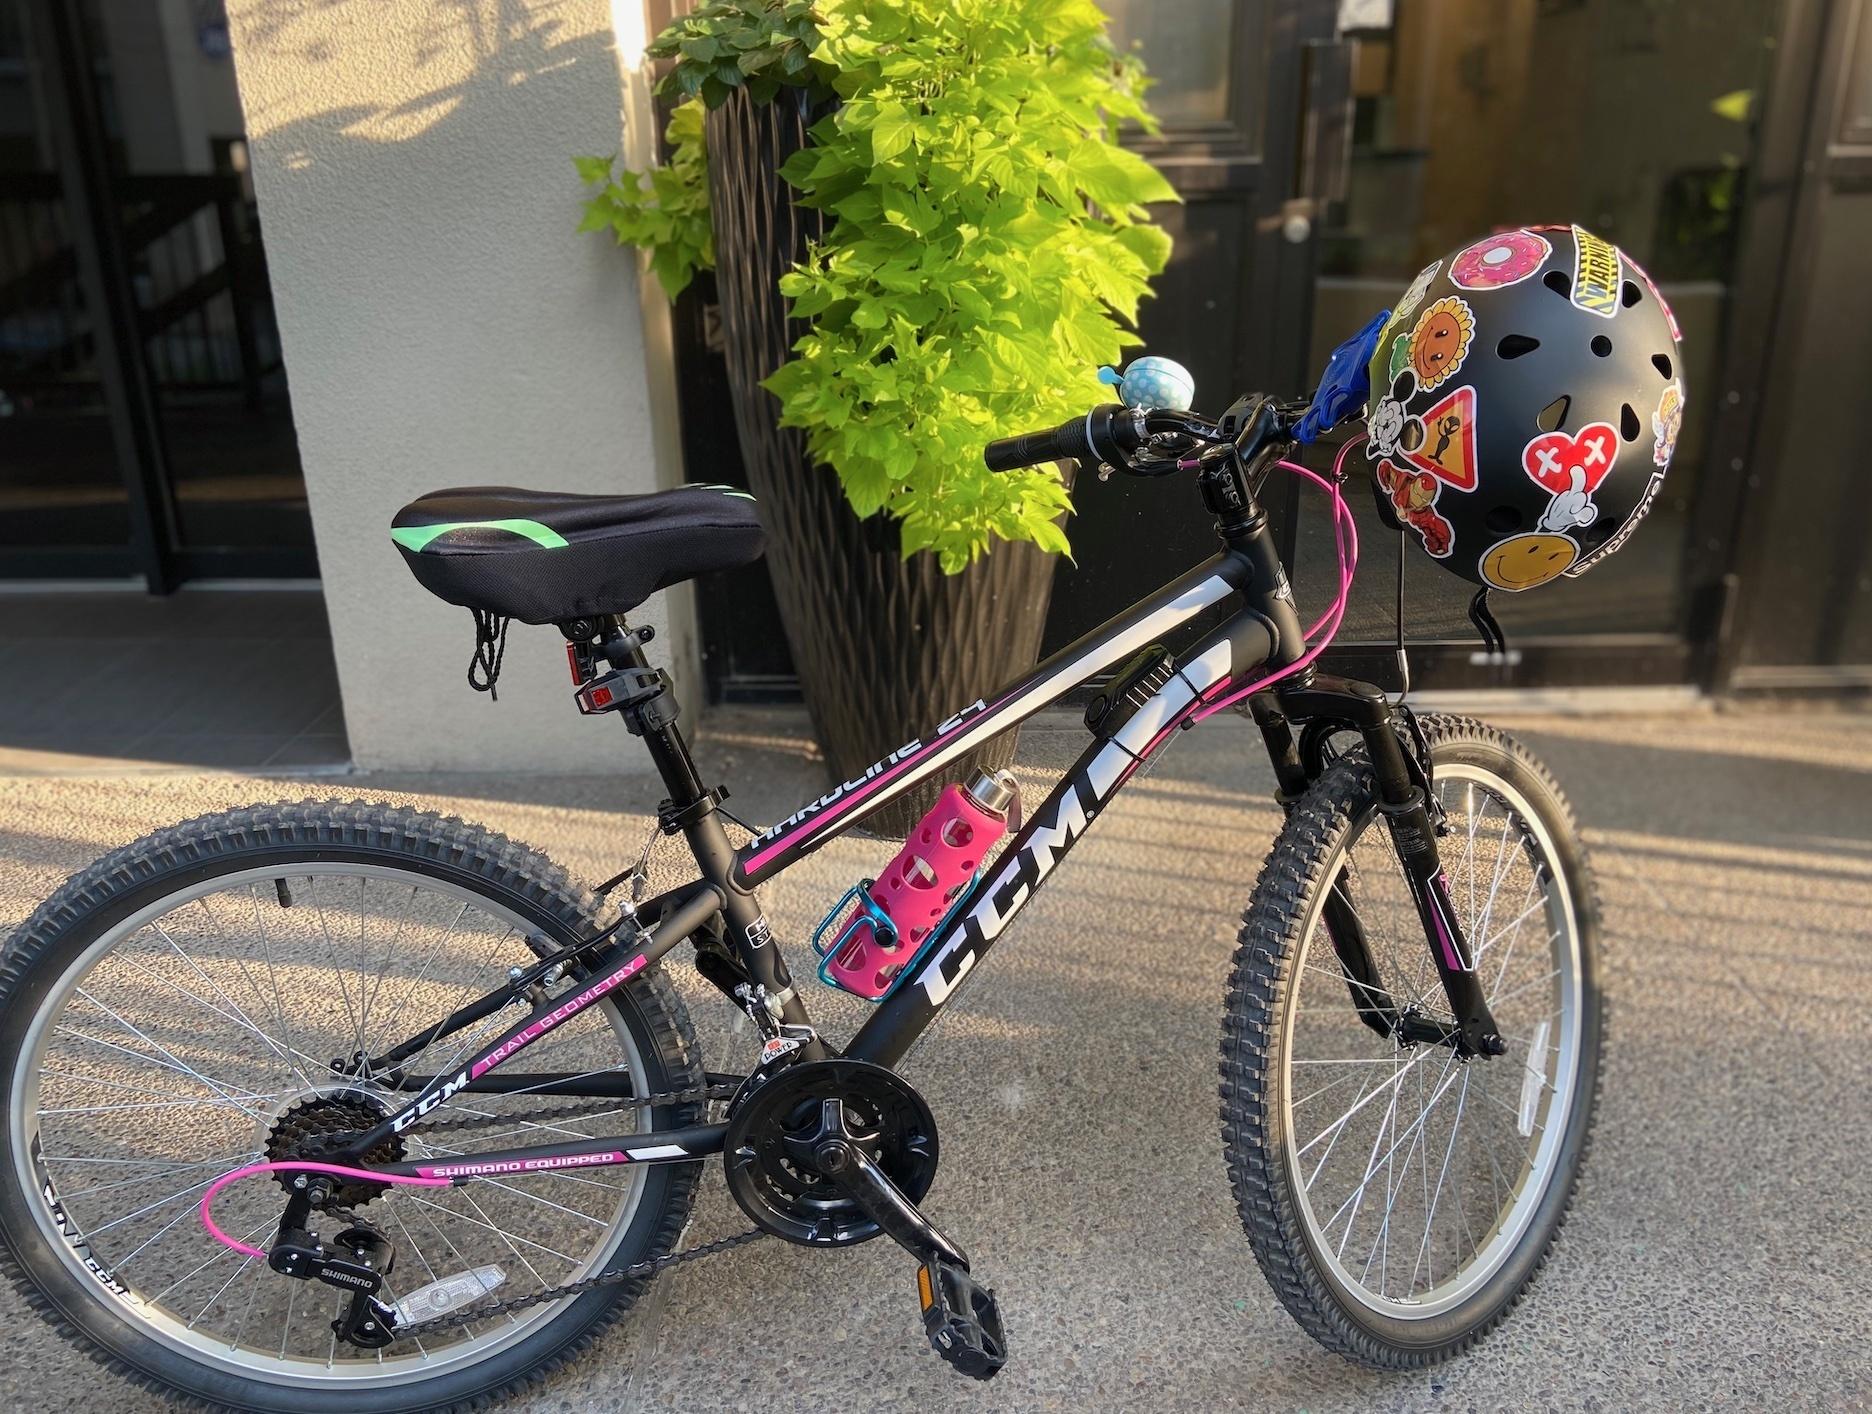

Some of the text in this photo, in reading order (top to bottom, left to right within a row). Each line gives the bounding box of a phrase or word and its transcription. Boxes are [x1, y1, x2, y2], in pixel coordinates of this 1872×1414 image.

[913, 784, 1088, 1007] CCM
[480, 961, 637, 1068] TRAIL GEOMETRY
[764, 1041, 792, 1060] POWER
[391, 1071, 470, 1133] CCM
[433, 1153, 614, 1178] SHIMANO EQUIPPED
[84, 1256, 125, 1294] CCM
[321, 1268, 373, 1289] SHIMANO
